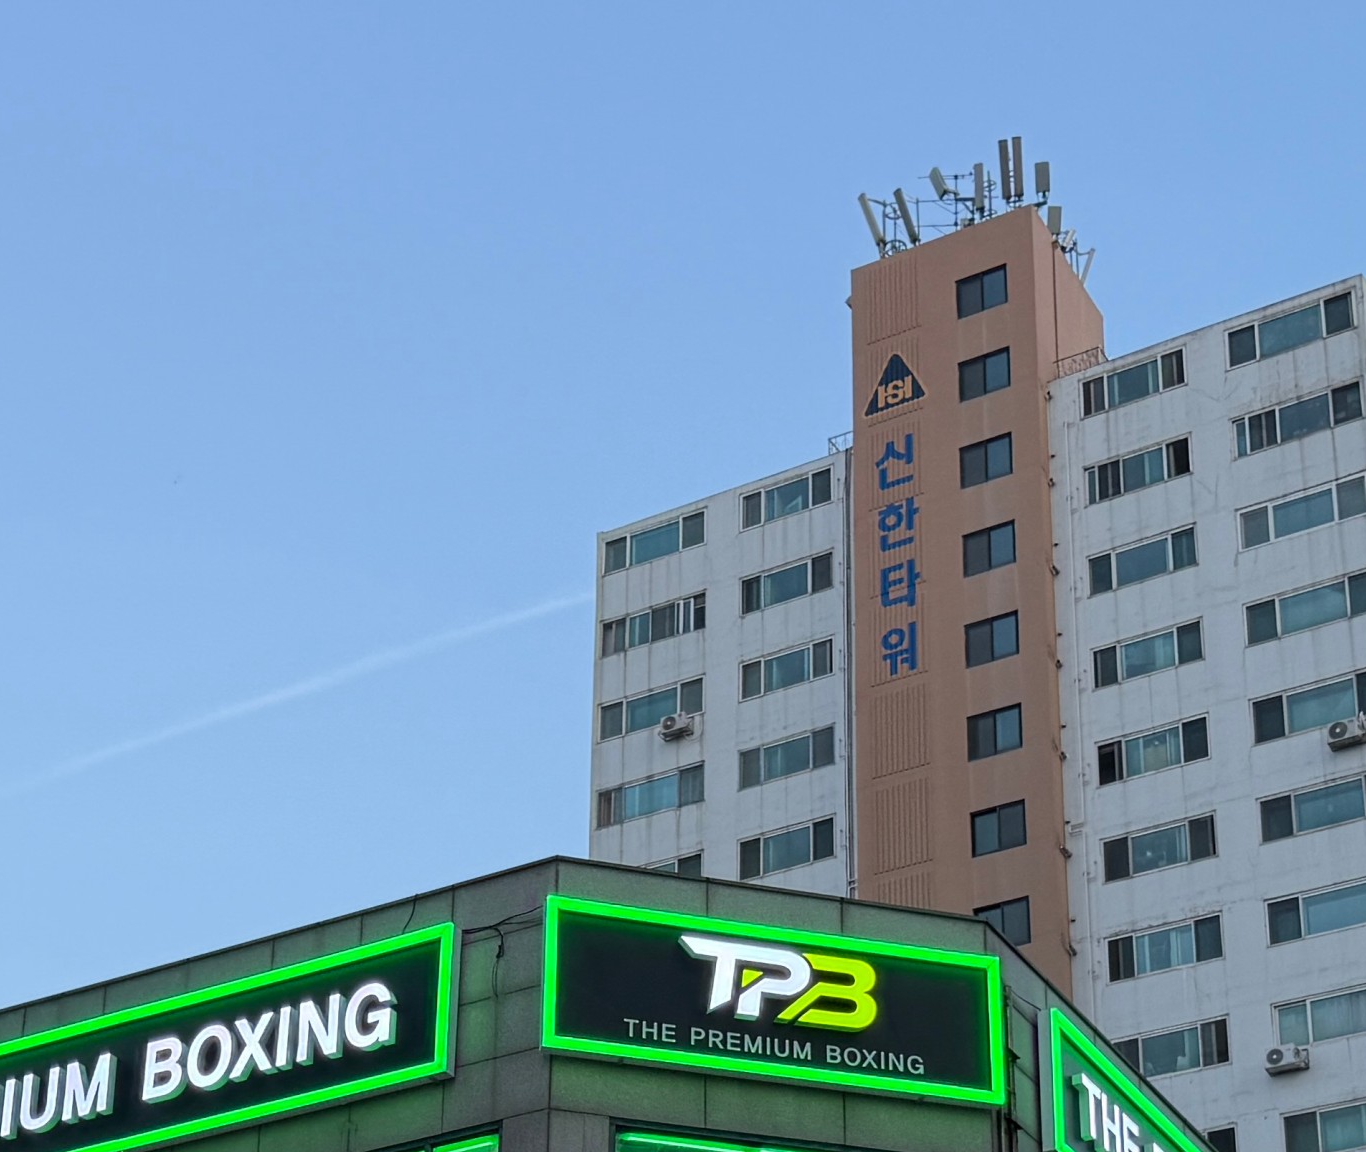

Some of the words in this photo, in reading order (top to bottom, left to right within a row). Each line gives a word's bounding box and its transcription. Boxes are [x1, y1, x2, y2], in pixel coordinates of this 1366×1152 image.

[875, 433, 922, 677] 신한타워
[678, 935, 877, 1032] TPB
[141, 982, 399, 1105] BOXING
[623, 1018, 676, 1043] THE
[690, 1027, 813, 1061] PREMIUM
[826, 1045, 925, 1075] BOXING
